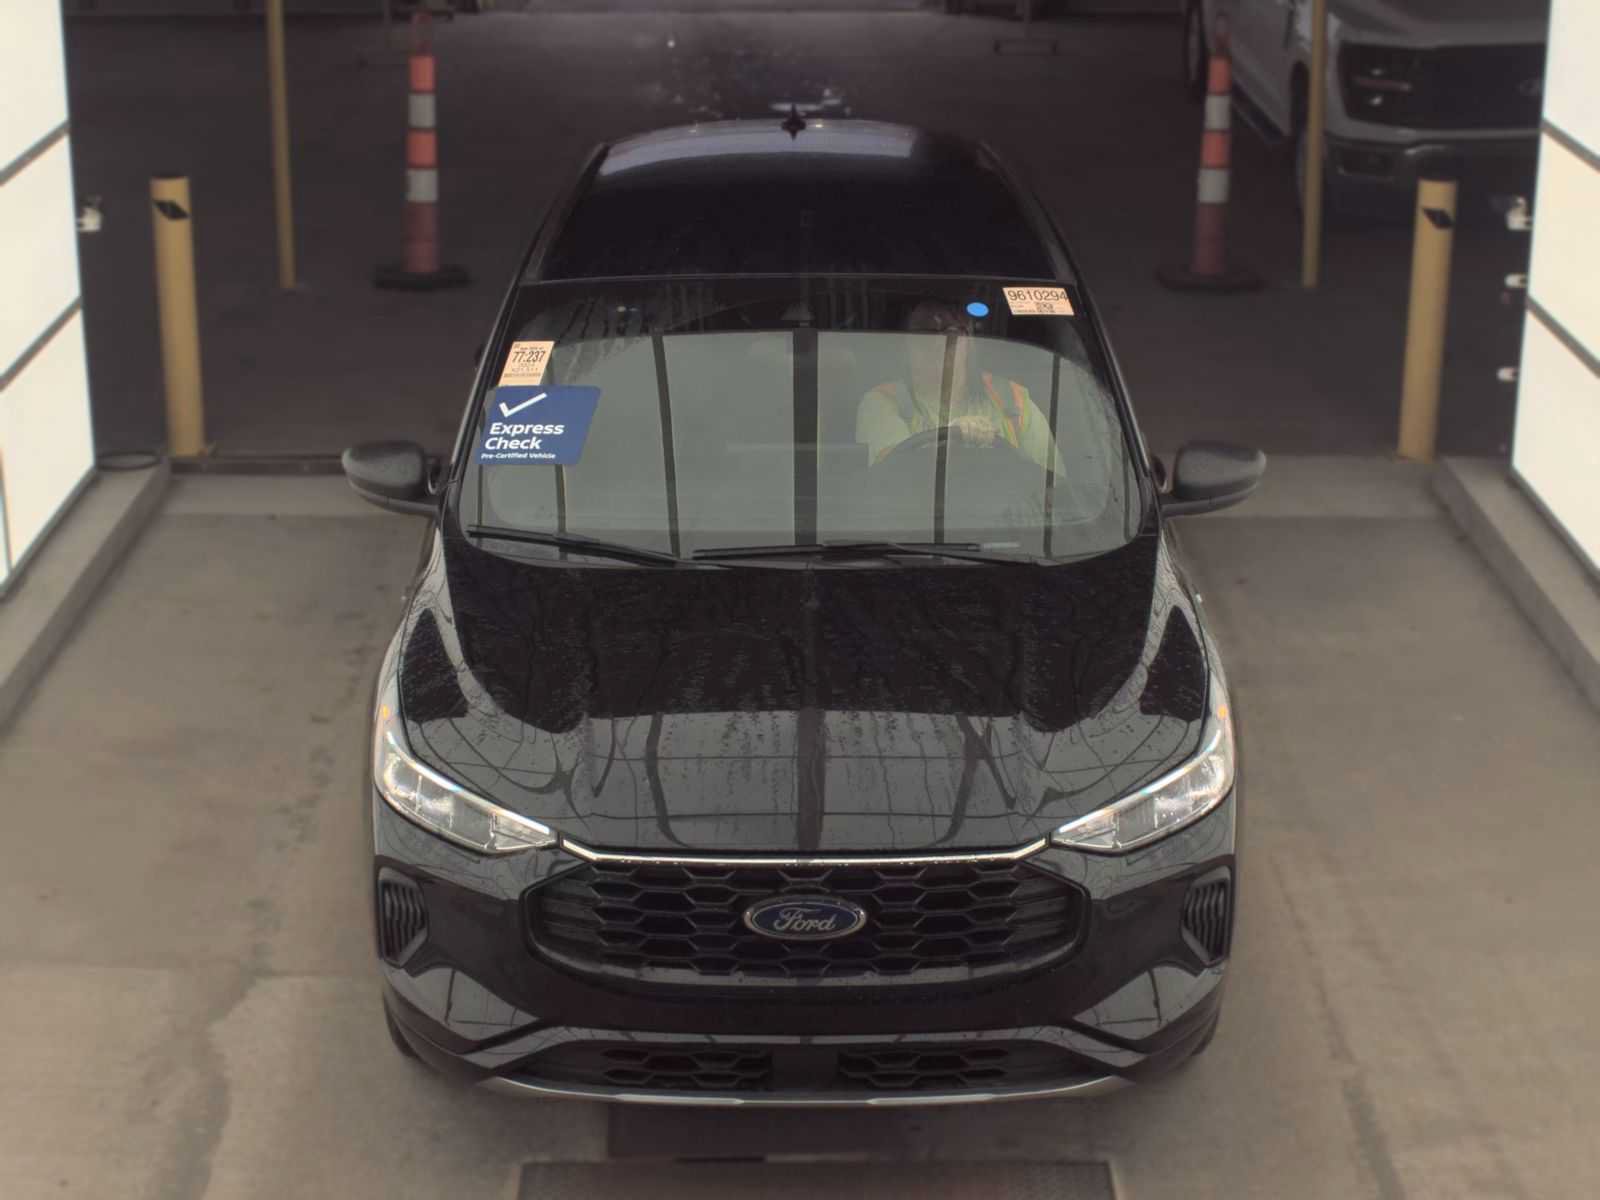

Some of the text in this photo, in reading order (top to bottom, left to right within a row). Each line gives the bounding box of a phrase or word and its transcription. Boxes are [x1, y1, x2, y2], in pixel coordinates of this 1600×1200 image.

[489, 422, 565, 437] Express
[484, 436, 542, 450] Check
[480, 452, 528, 460] Pre-Certified
[773, 906, 839, 932] Ford
